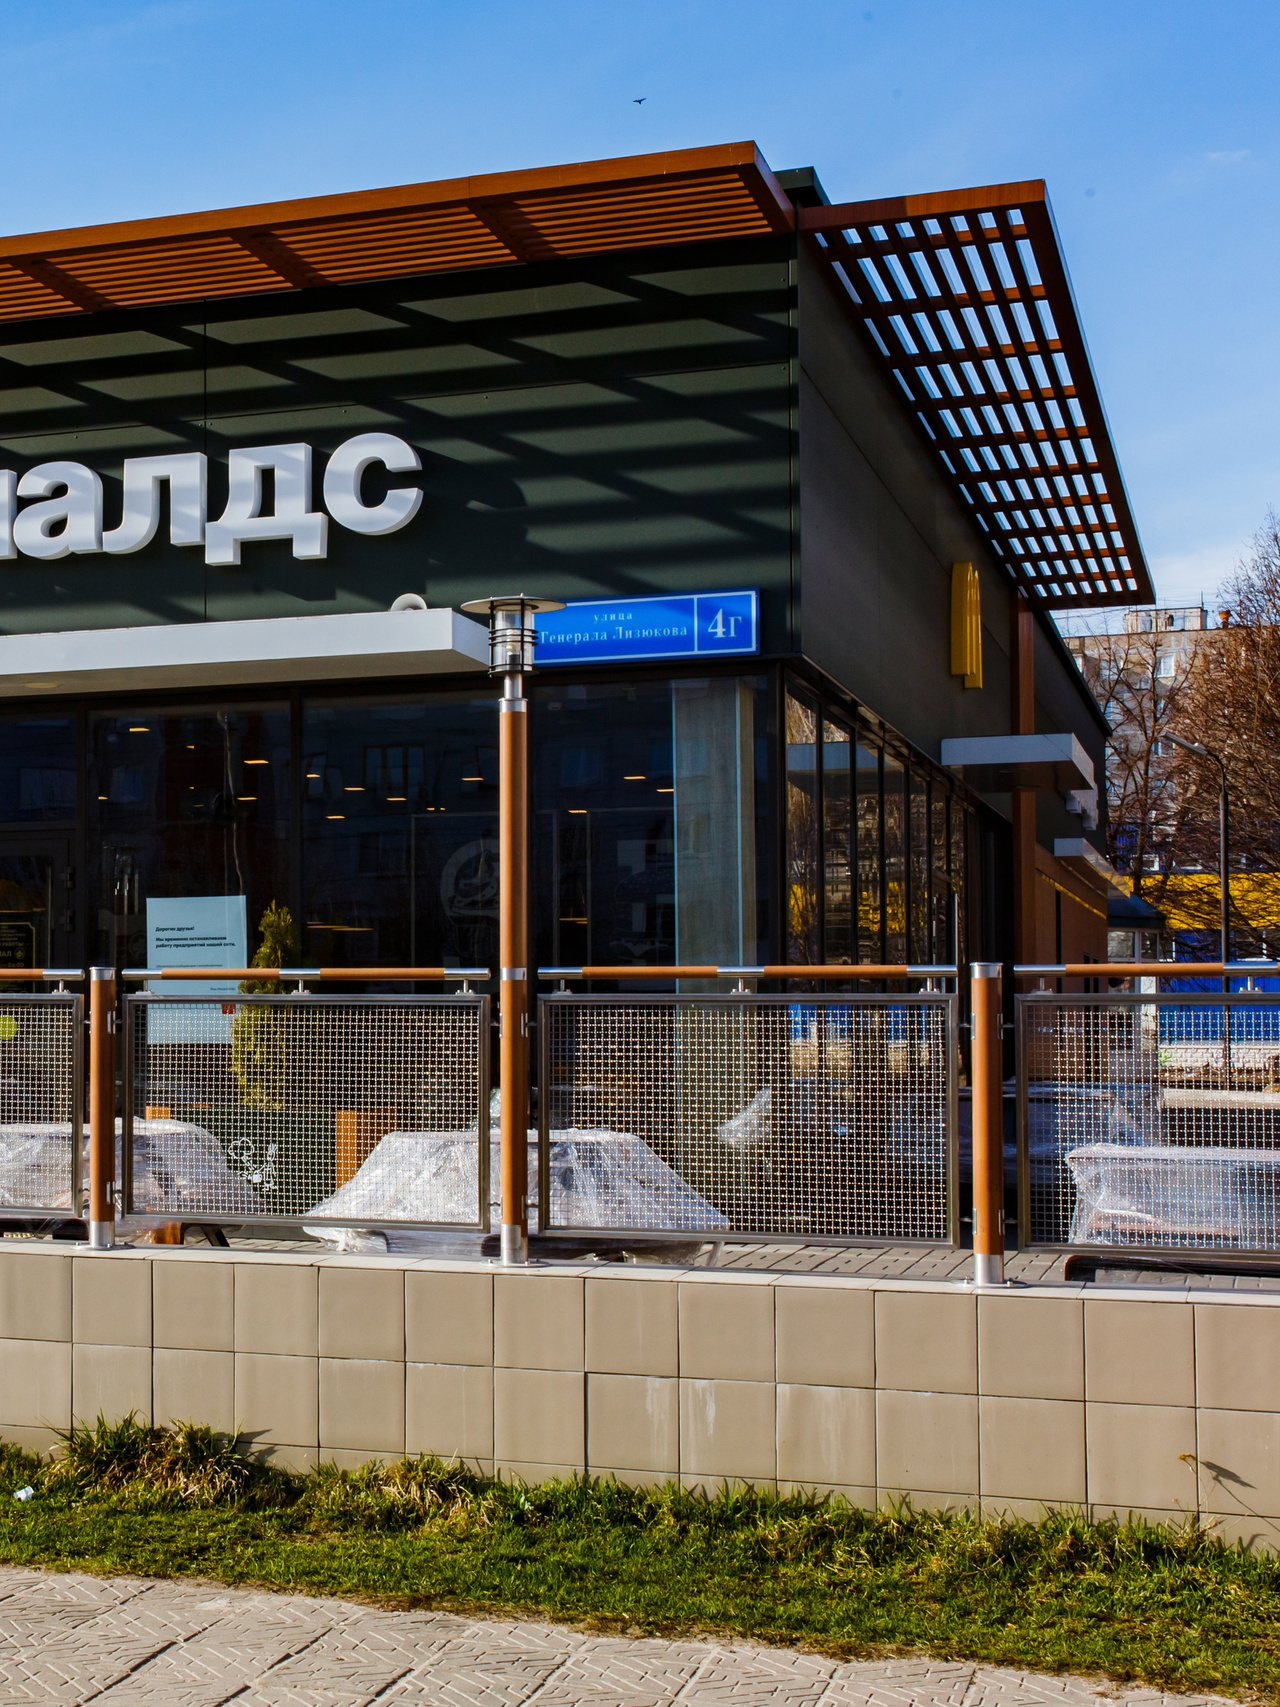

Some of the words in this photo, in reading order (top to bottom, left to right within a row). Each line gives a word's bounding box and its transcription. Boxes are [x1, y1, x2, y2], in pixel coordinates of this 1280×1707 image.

[593, 612, 633, 623] улица
[540, 627, 608, 645] Генерала
[612, 625, 688, 641] Лизюкова
